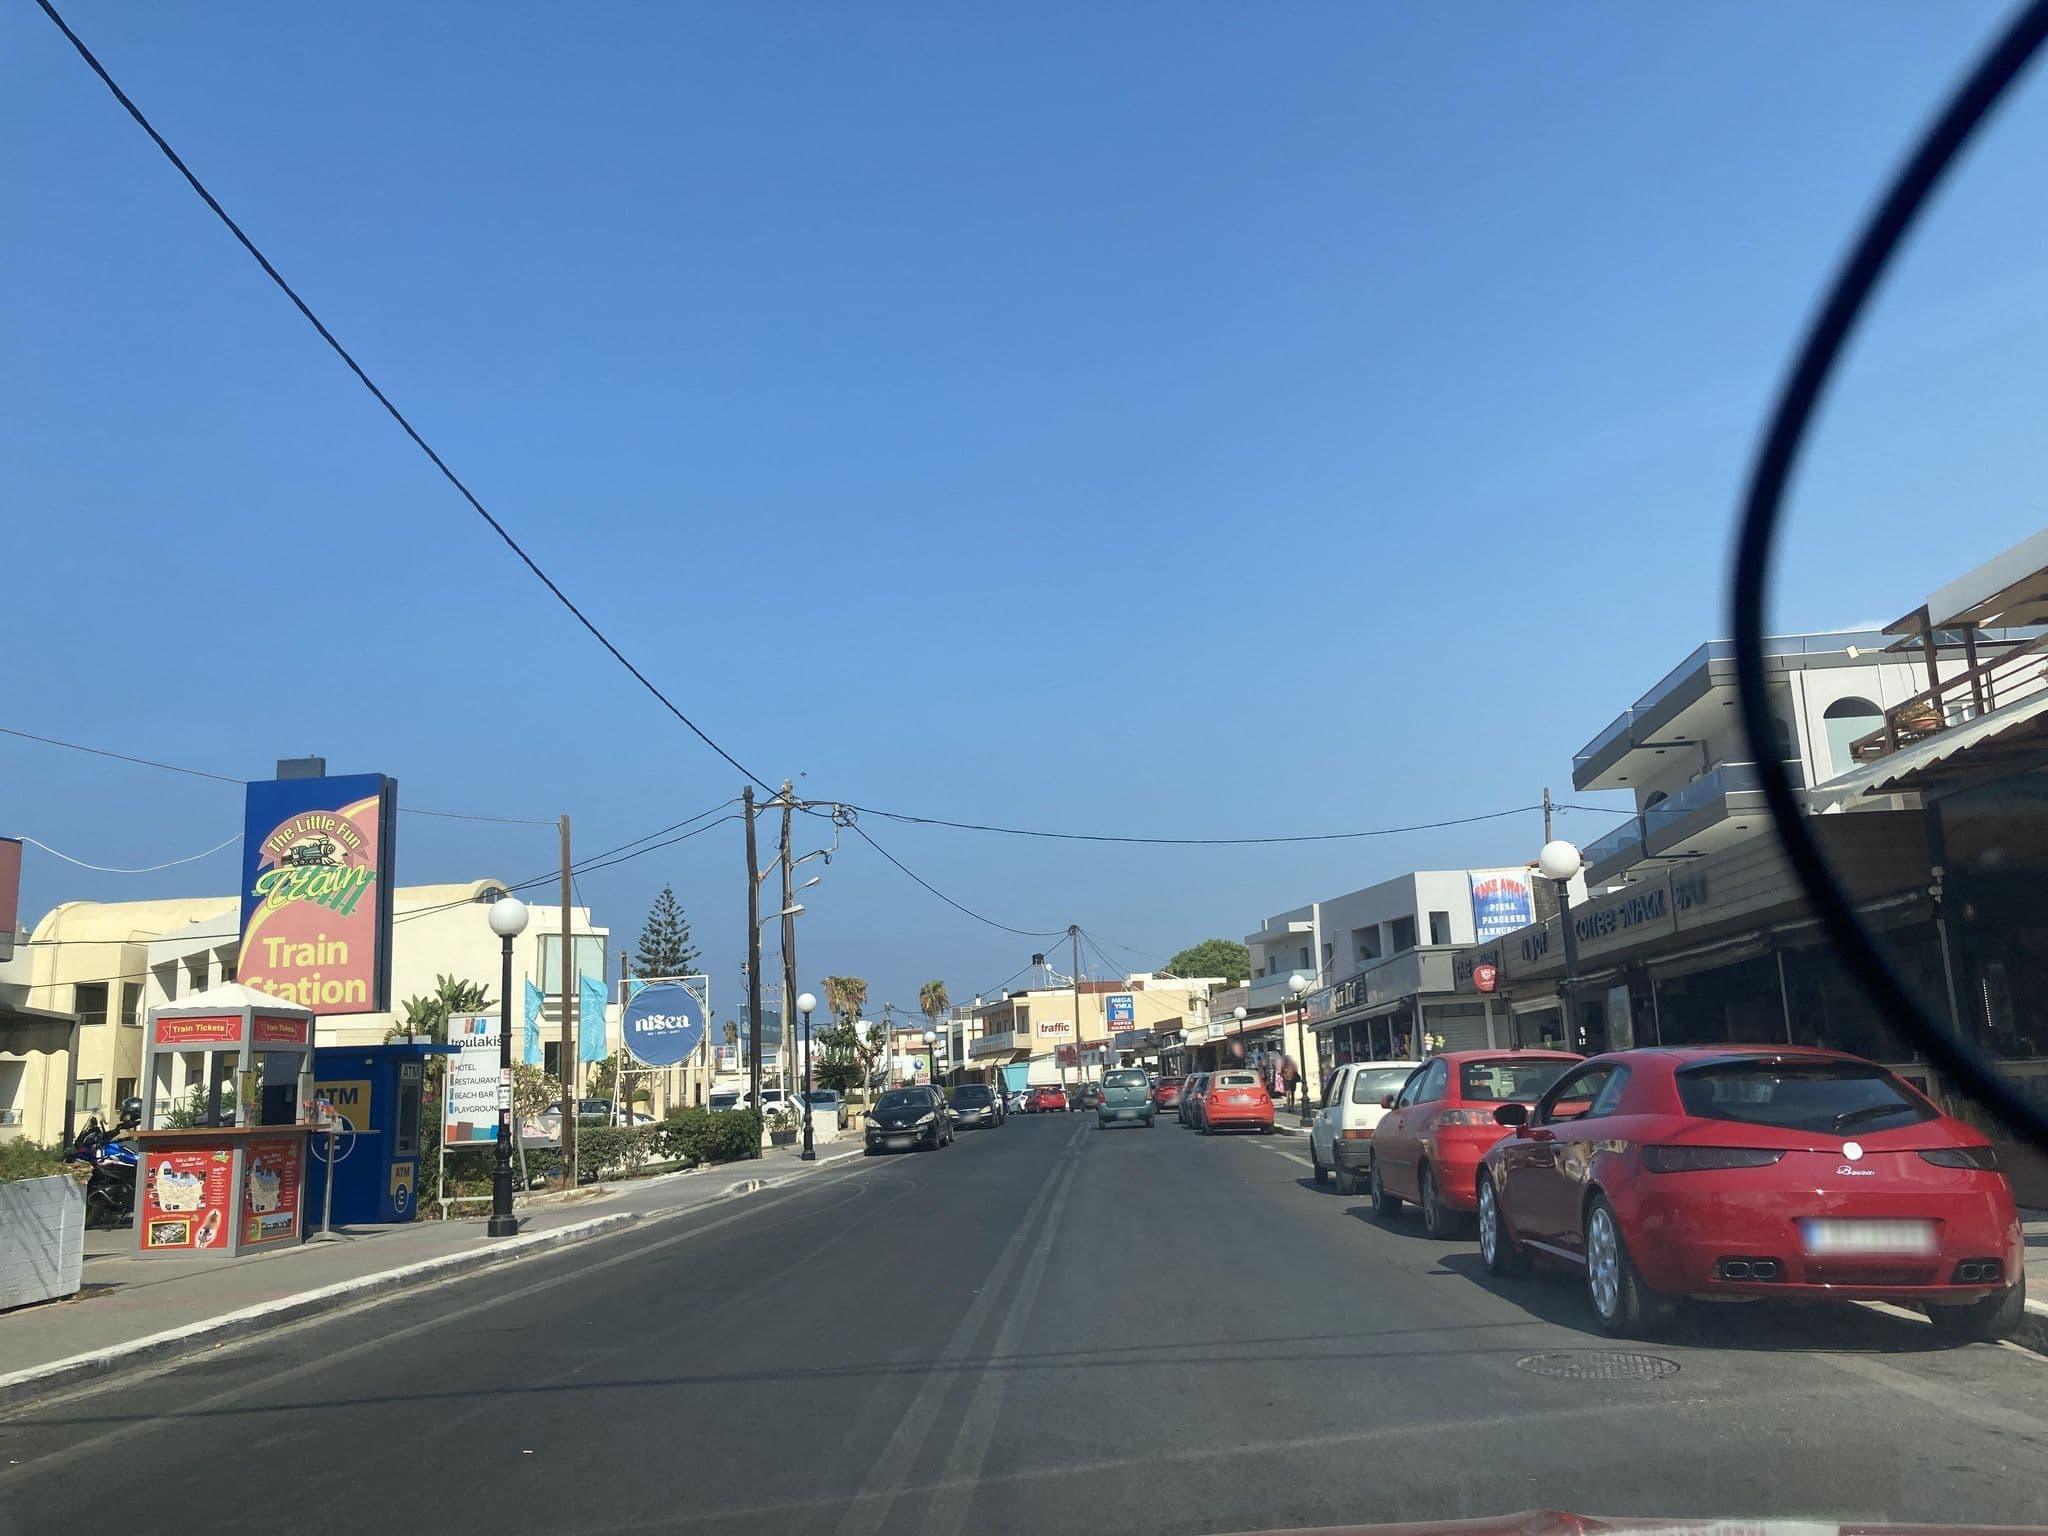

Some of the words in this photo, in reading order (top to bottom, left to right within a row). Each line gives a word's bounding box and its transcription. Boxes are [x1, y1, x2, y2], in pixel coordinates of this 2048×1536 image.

[266, 825, 295, 853] The
[295, 815, 336, 833] Little
[335, 820, 362, 850] Fun
[255, 863, 366, 911] Train
[1482, 914, 1526, 925] PANCAKES
[262, 933, 349, 969] Train
[172, 1025, 193, 1033] Train
[196, 1023, 225, 1032] Tickets
[635, 1014, 691, 1032] nisea
[1041, 1023, 1070, 1033] traffic
[403, 1065, 420, 1078] ATM
[455, 1063, 477, 1072] HOTEL
[454, 1076, 500, 1086] RESTAURANT
[314, 1087, 359, 1105] ATM
[454, 1091, 477, 1100] BEACH
[478, 1090, 494, 1098] BAR
[454, 1104, 498, 1114] PLAYGROUN
[395, 1166, 410, 1178] ATM
